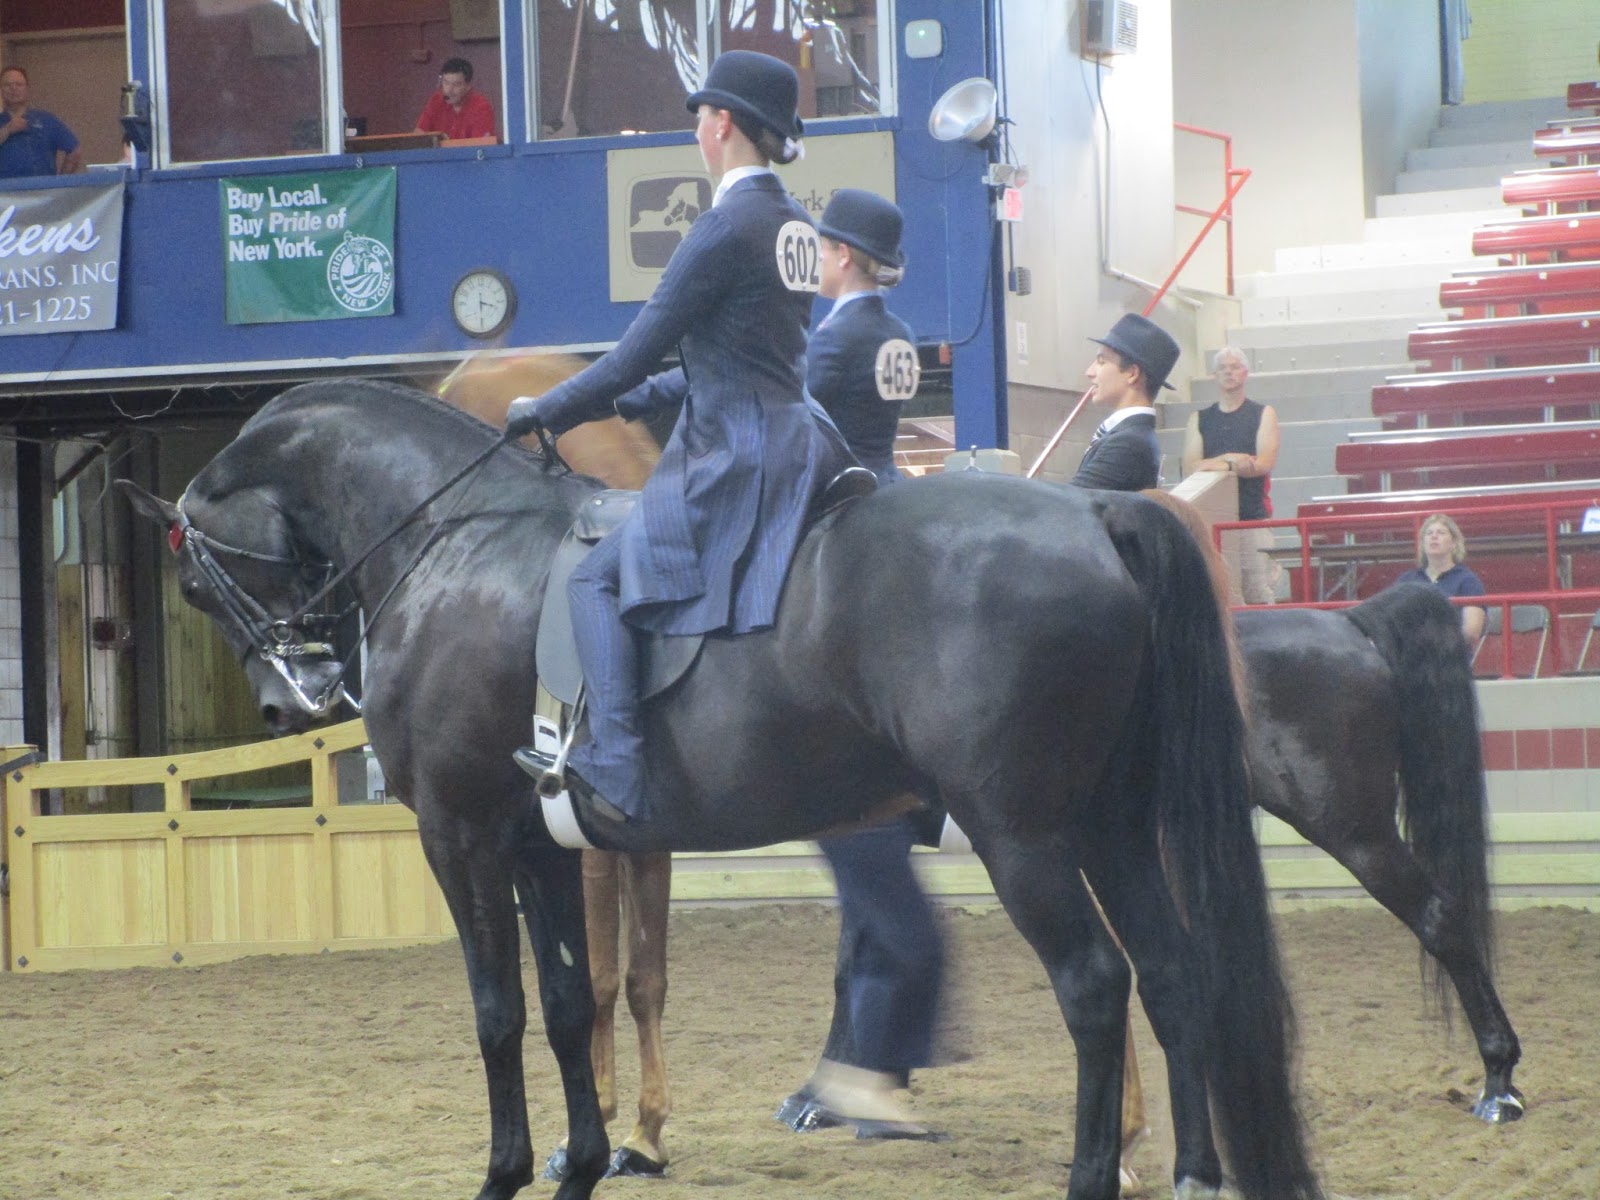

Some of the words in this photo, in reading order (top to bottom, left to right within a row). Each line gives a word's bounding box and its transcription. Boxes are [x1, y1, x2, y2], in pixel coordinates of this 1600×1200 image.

[227, 187, 264, 212] Buy
[268, 183, 328, 208] Local.
[228, 213, 264, 239] Buy
[269, 210, 322, 233] Pride
[326, 206, 347, 229] of
[229, 239, 270, 262] New
[273, 235, 324, 260] York.
[331, 247, 350, 281] PRIDE
[371, 244, 386, 257] OF
[784, 234, 820, 285] 602
[0, 264, 63, 290] ANS.
[341, 293, 368, 307] NEW
[371, 272, 391, 303] YORK
[0, 295, 92, 325] 1-1225
[882, 351, 914, 395] 463
